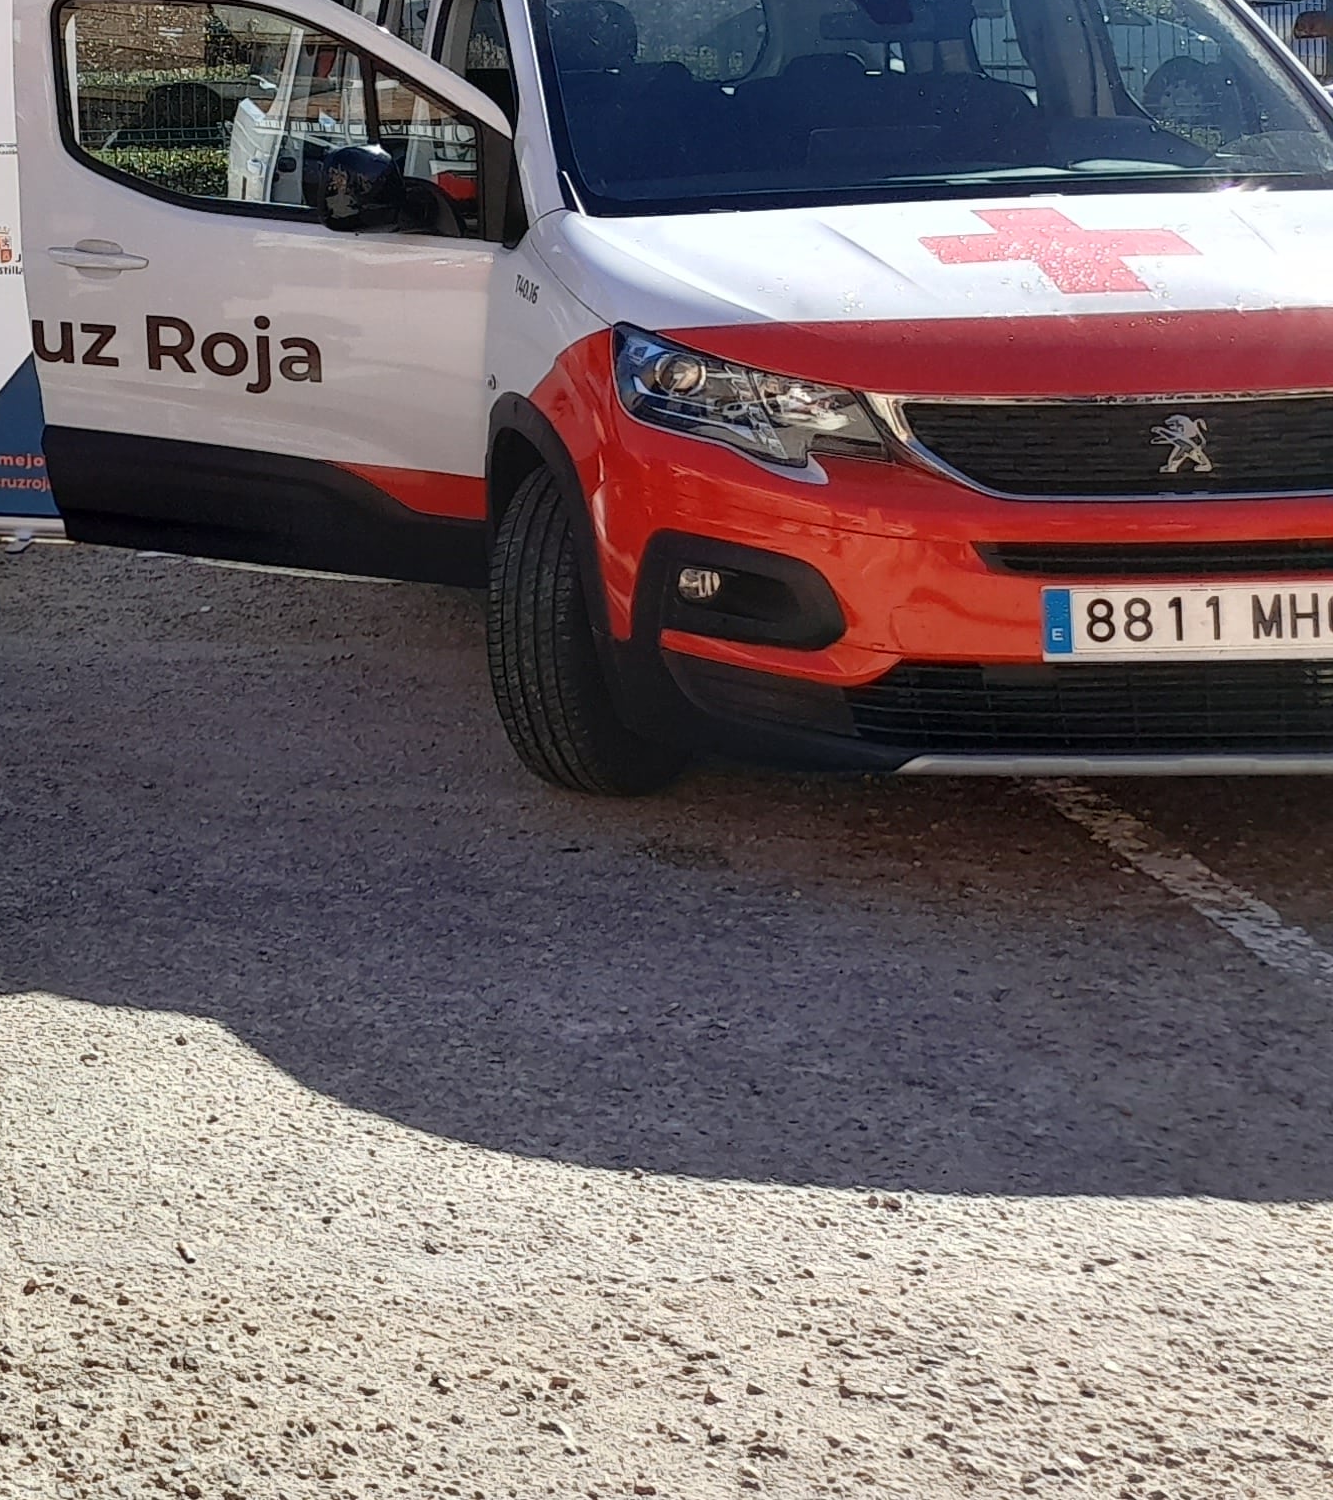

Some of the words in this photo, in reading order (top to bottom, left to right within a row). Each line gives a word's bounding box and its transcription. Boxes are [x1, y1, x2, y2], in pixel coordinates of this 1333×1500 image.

[145, 314, 323, 394] Roja
[1051, 627, 1064, 641] E
[1086, 595, 1221, 643] 8811
